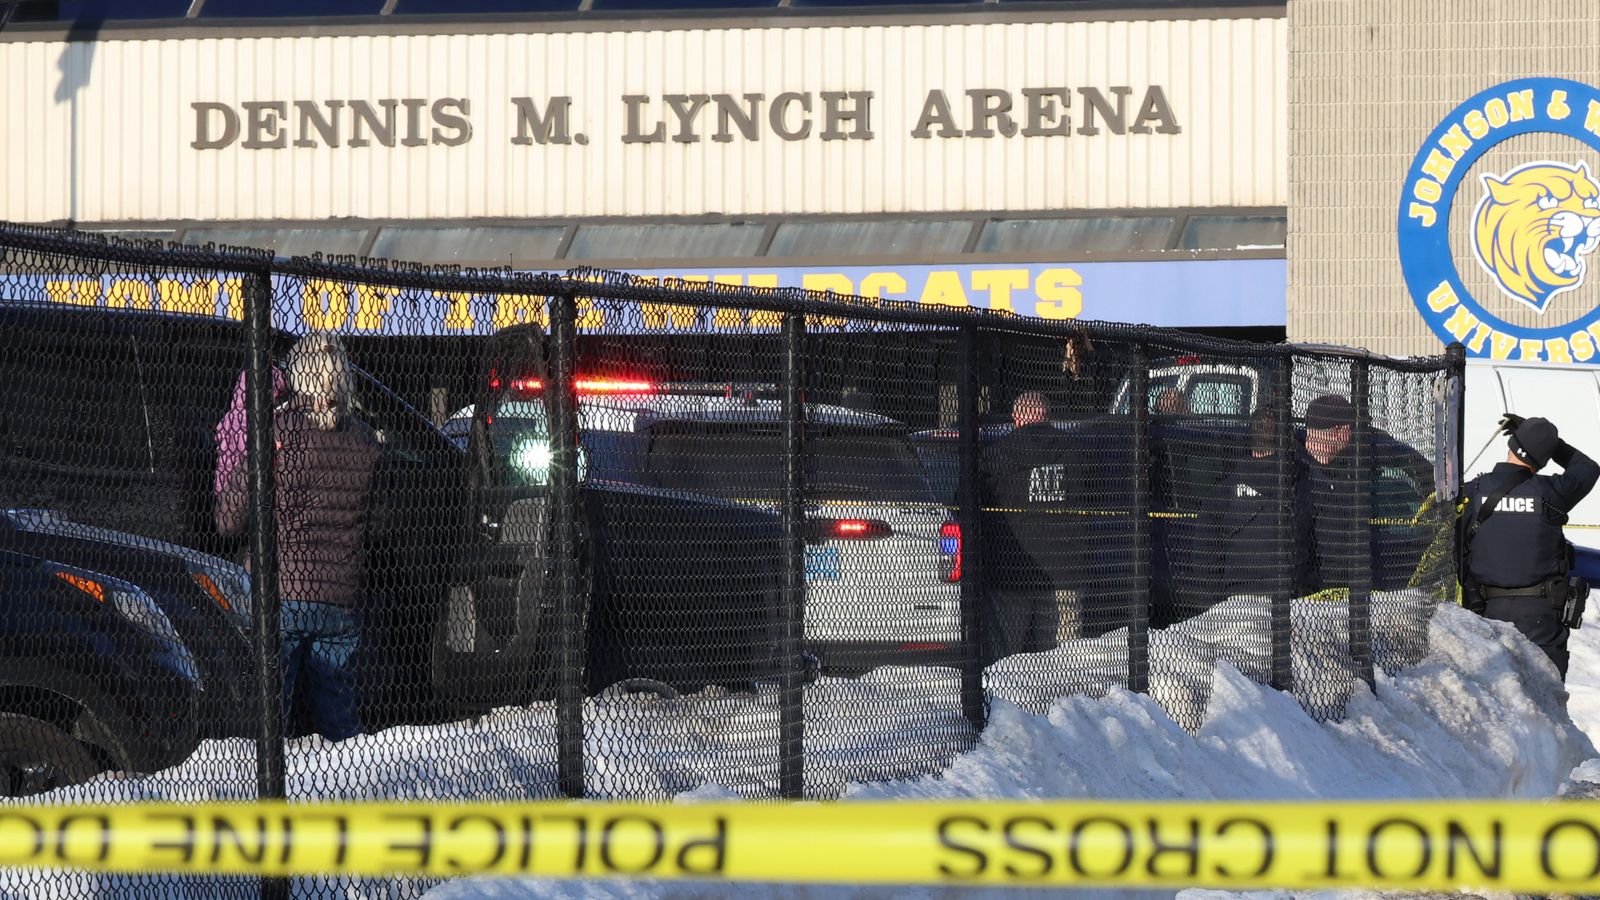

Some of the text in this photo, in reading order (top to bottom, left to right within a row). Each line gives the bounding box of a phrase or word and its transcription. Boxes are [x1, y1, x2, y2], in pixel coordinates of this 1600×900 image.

[191, 85, 1181, 149] DENNIS M. LYNCH ARENA
[1409, 89, 1534, 227] JOHNSON
[1547, 90, 1571, 121] &
[303, 278, 400, 329] OF
[631, 267, 1084, 329] WILDCATS
[1481, 496, 1534, 512] LICE
[0, 811, 110, 867] DO
[146, 812, 347, 870] LINE
[387, 814, 728, 874] POLICE
[936, 815, 1275, 879] CROSS
[1303, 817, 1501, 881] NOT
